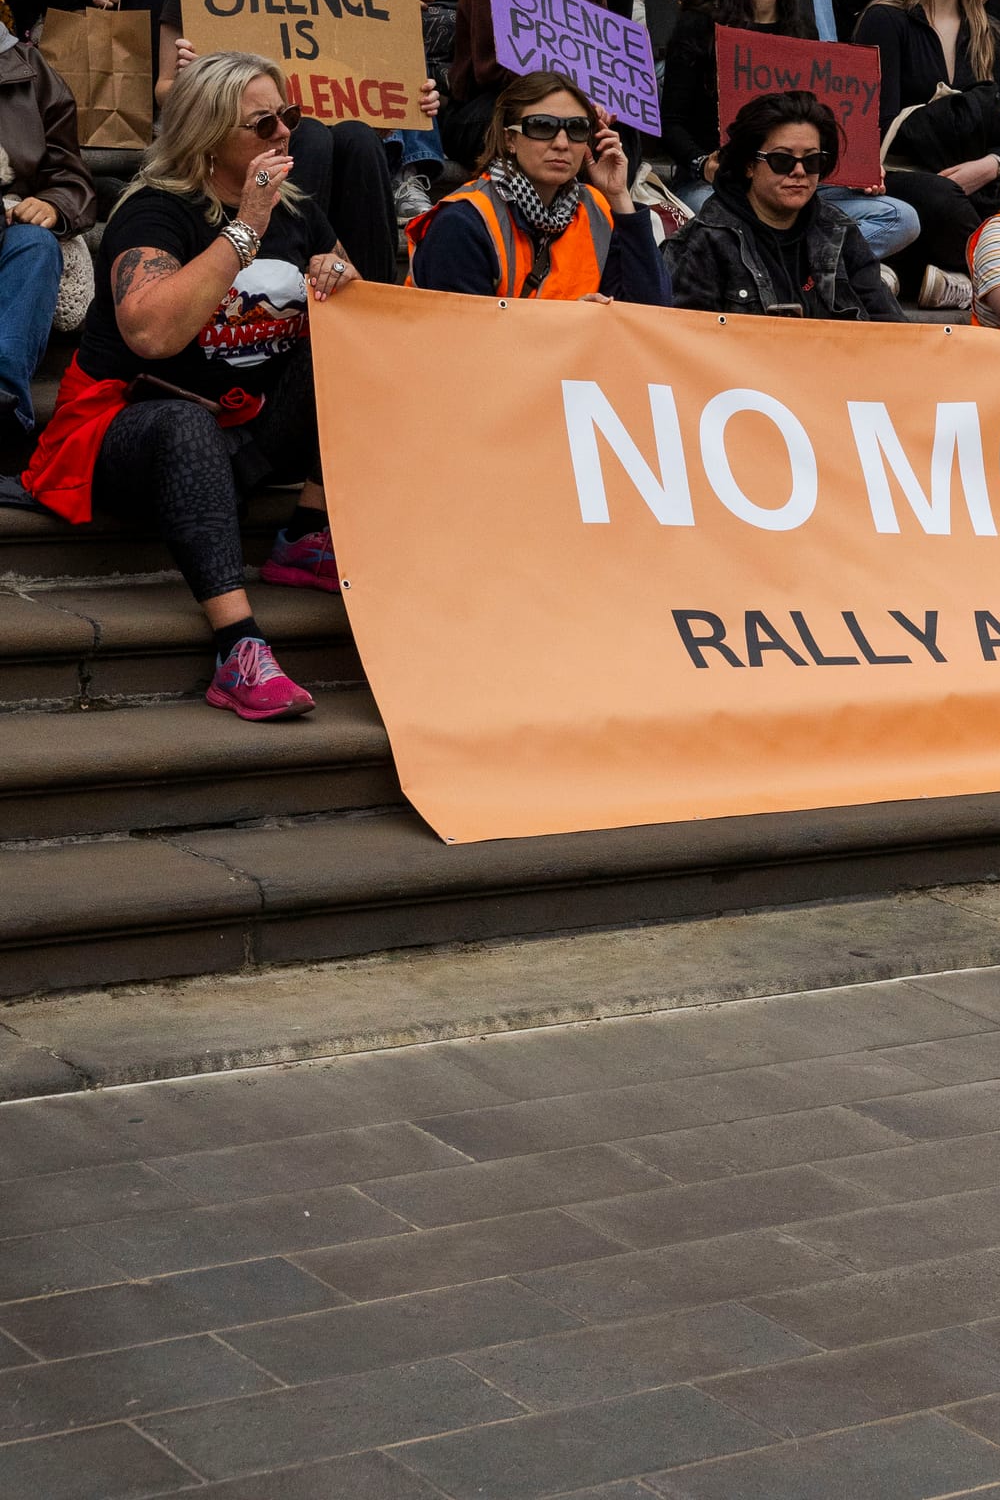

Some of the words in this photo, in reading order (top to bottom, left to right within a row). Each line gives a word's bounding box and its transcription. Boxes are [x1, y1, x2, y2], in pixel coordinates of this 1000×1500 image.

[280, 20, 320, 60] IS
[509, 7, 655, 97] PROTECTS
[285, 71, 409, 120] LENCE
[734, 43, 801, 90] How
[809, 58, 878, 116] Many
[561, 379, 818, 531] NO
[671, 608, 948, 669] RALLY
